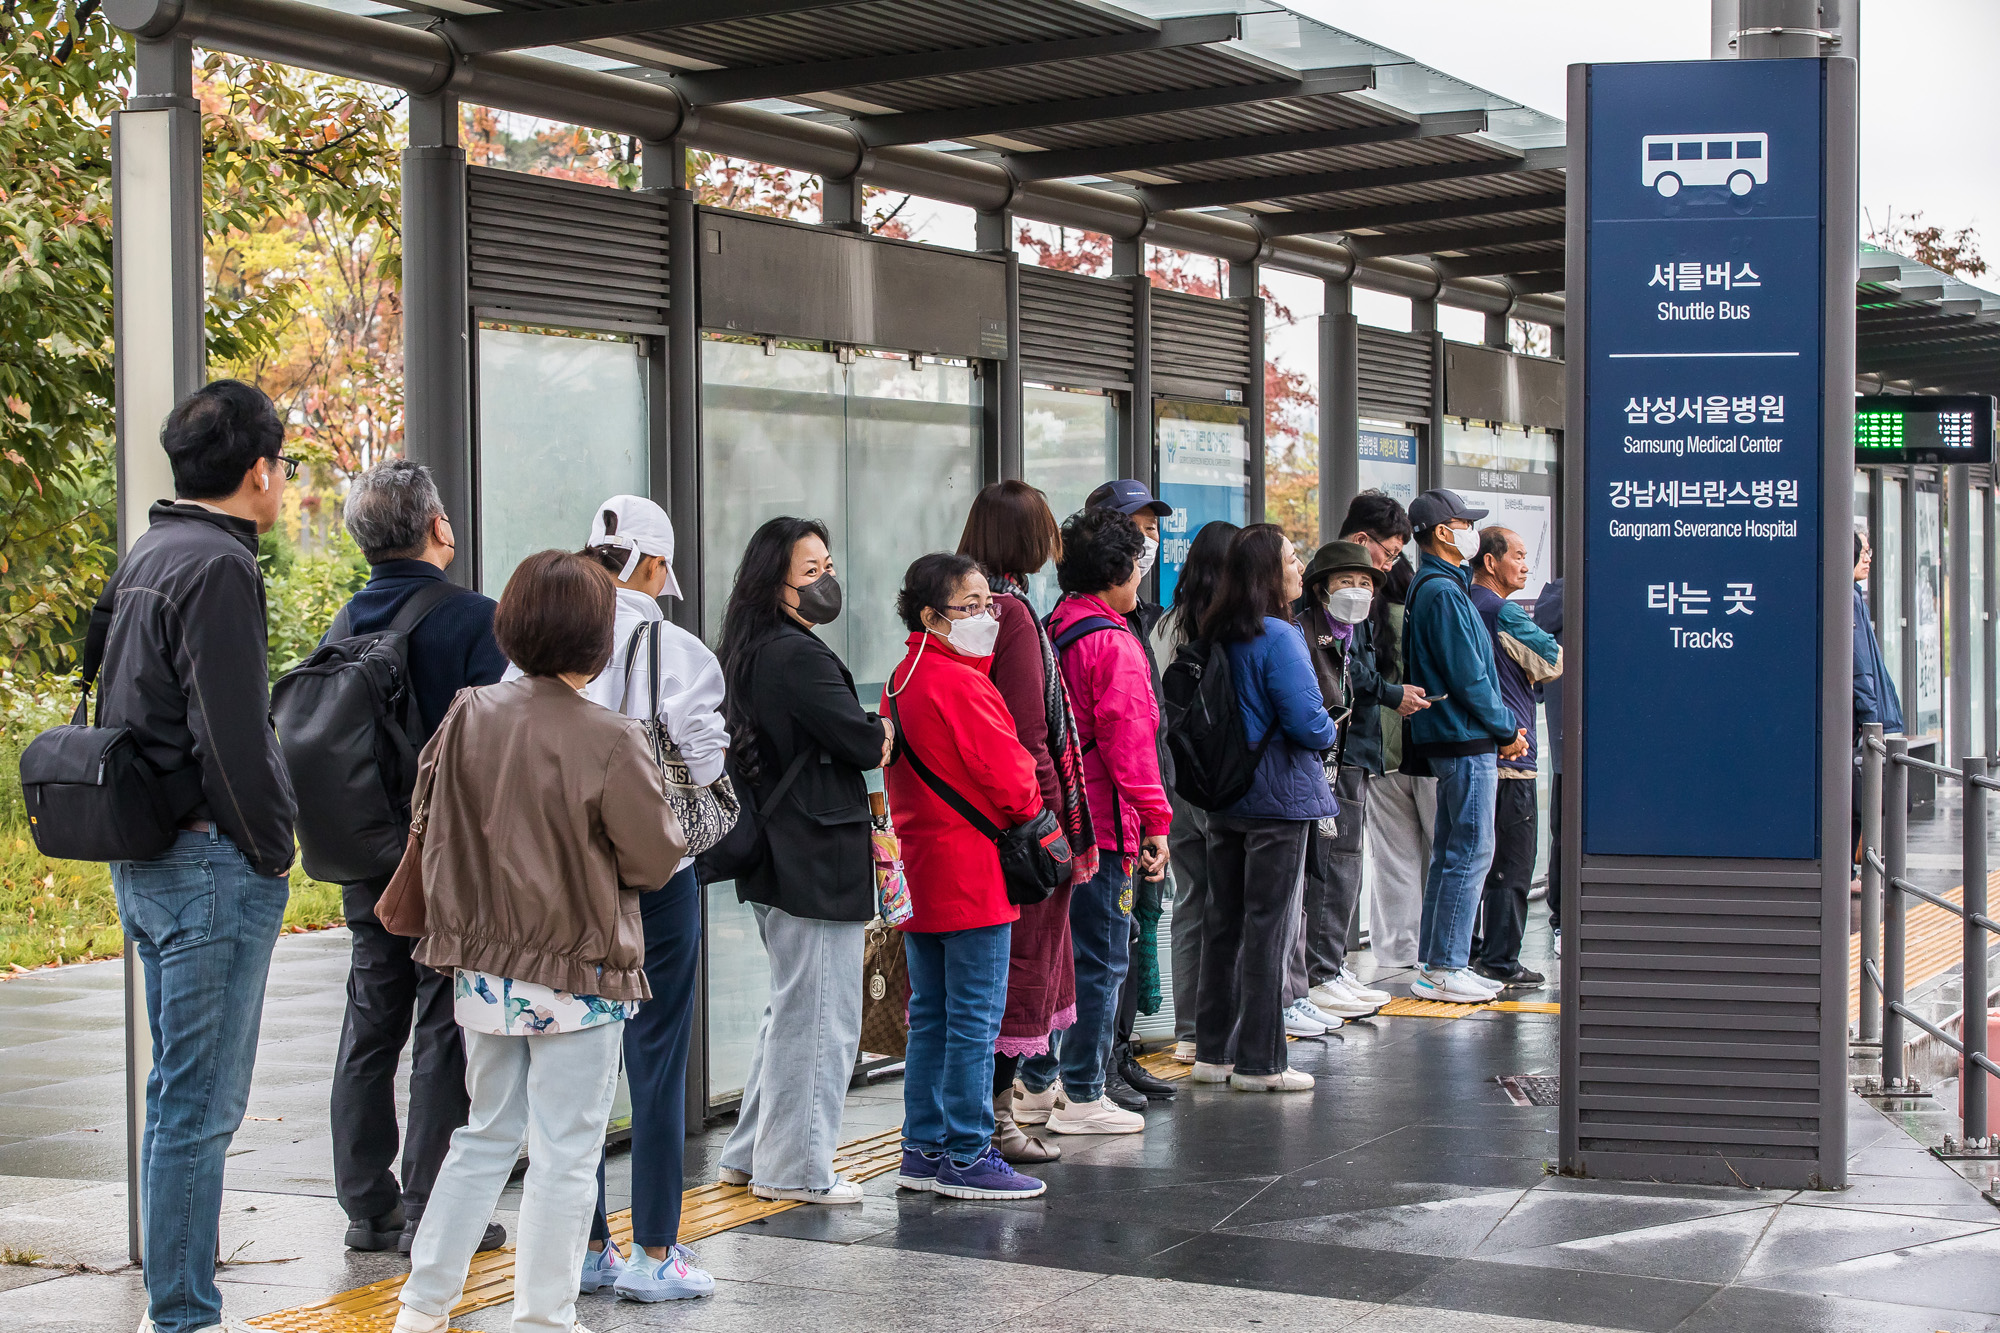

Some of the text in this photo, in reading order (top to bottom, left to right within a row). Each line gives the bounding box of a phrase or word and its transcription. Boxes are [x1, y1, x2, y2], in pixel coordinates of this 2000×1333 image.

[1648, 262, 1761, 291] 셔틀버스
[1658, 301, 1750, 320] Shuttle Bus
[1624, 395, 1784, 424] 삼성서울병원
[1624, 435, 1783, 456] Samsung Medical Center
[1609, 480, 1798, 508] 강남세브란스병원
[1609, 520, 1797, 540] Gangnam Severance Hospital
[1648, 582, 1756, 615] 타는 곳
[1670, 628, 1734, 649] Tracks
